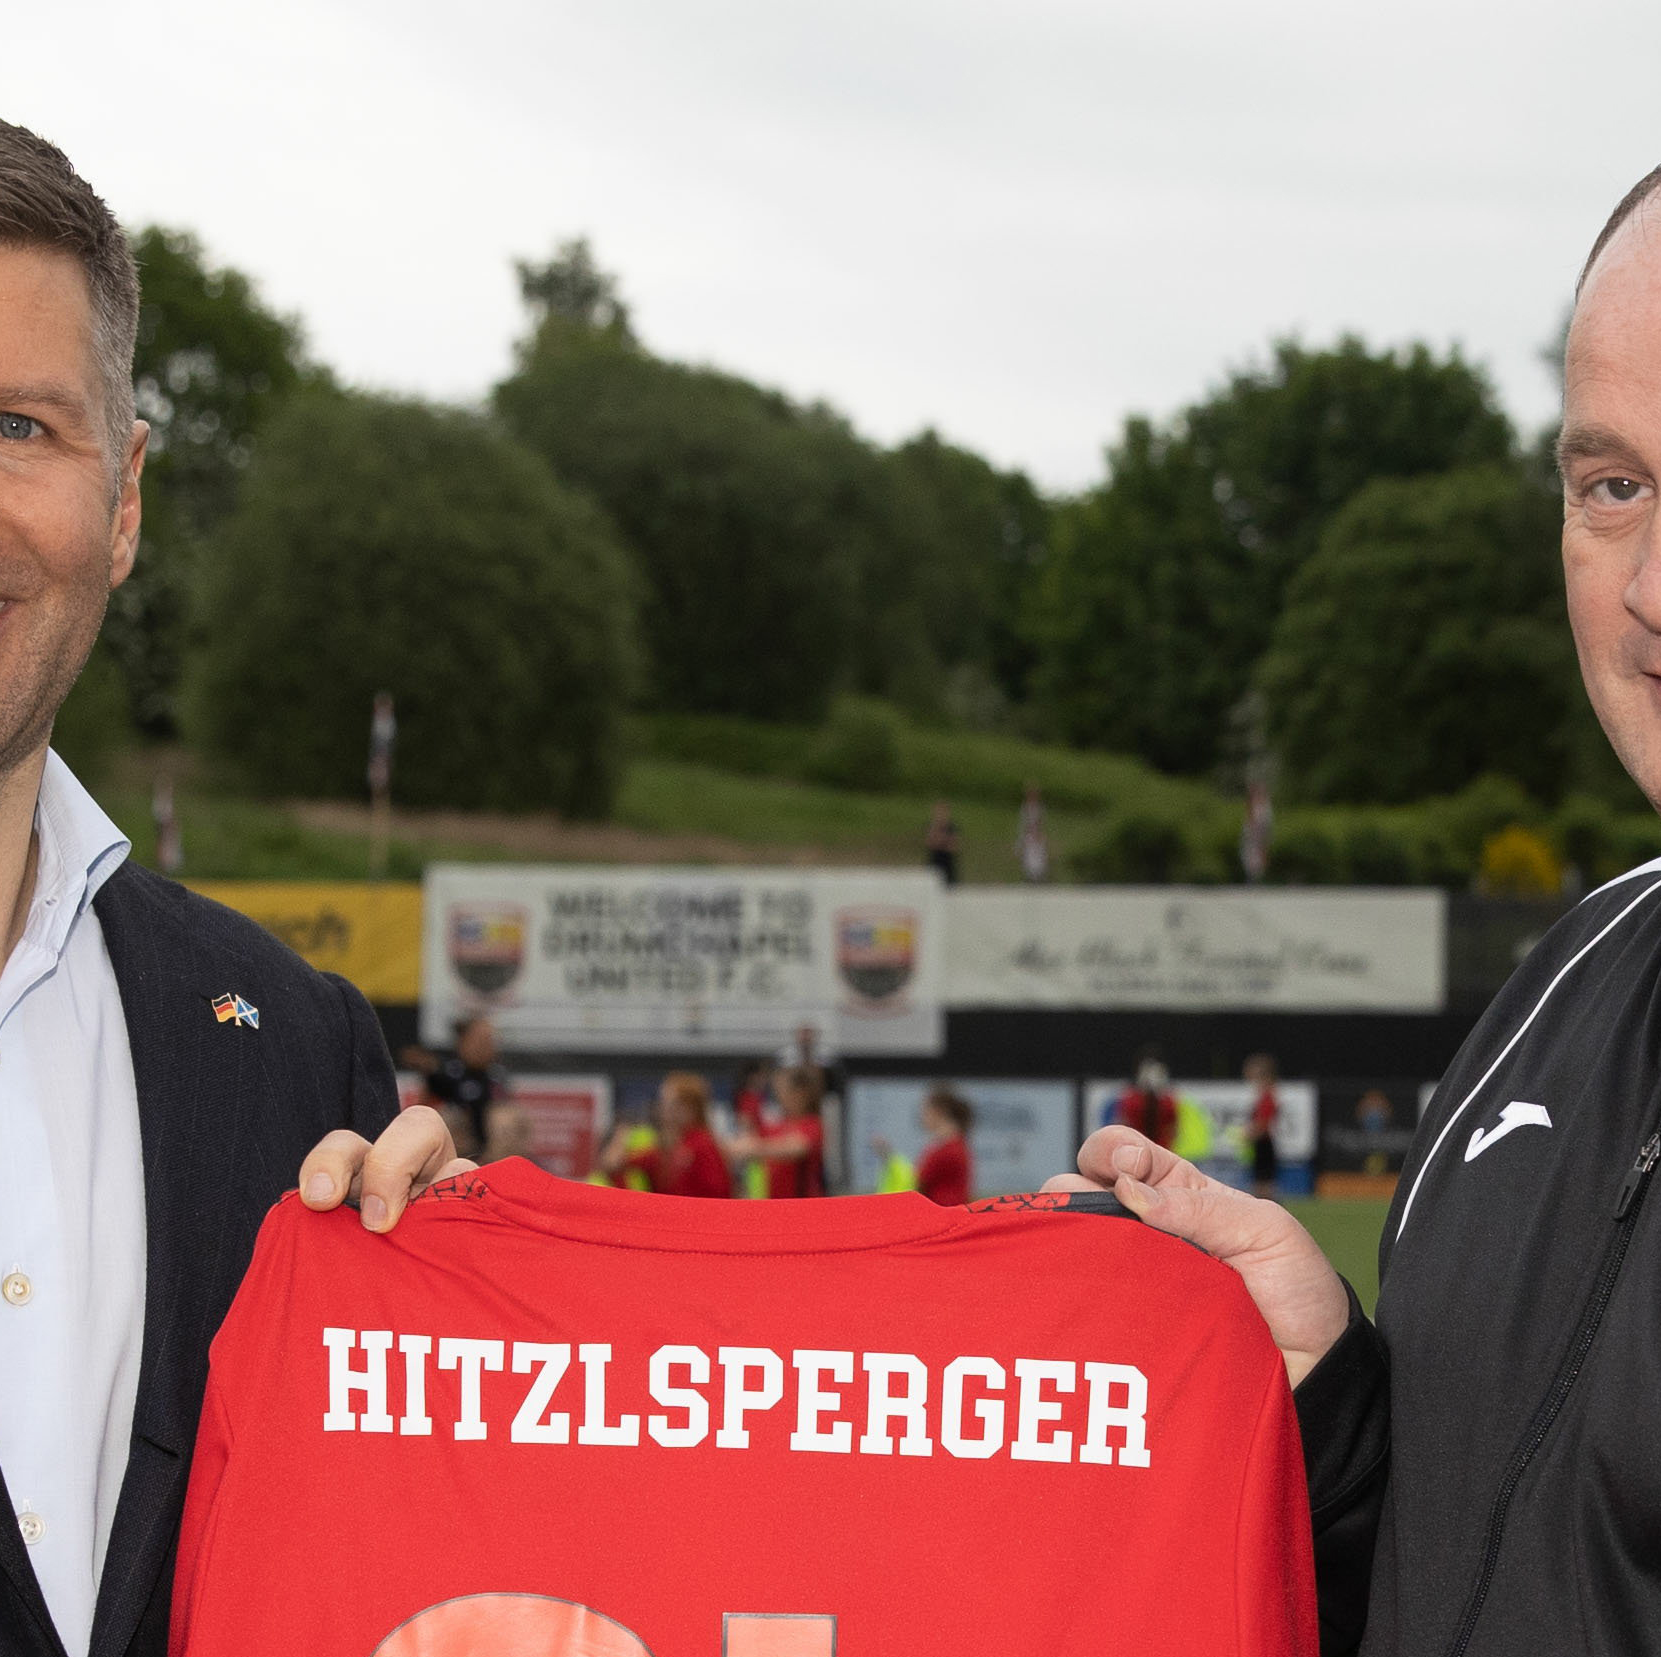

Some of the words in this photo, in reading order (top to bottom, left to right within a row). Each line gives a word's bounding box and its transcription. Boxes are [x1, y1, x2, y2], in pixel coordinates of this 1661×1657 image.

[547, 885, 744, 919] WELCOME
[759, 889, 814, 923] TO
[564, 962, 709, 993] UNITED
[322, 1327, 1151, 1468] HITZLSPERGER
